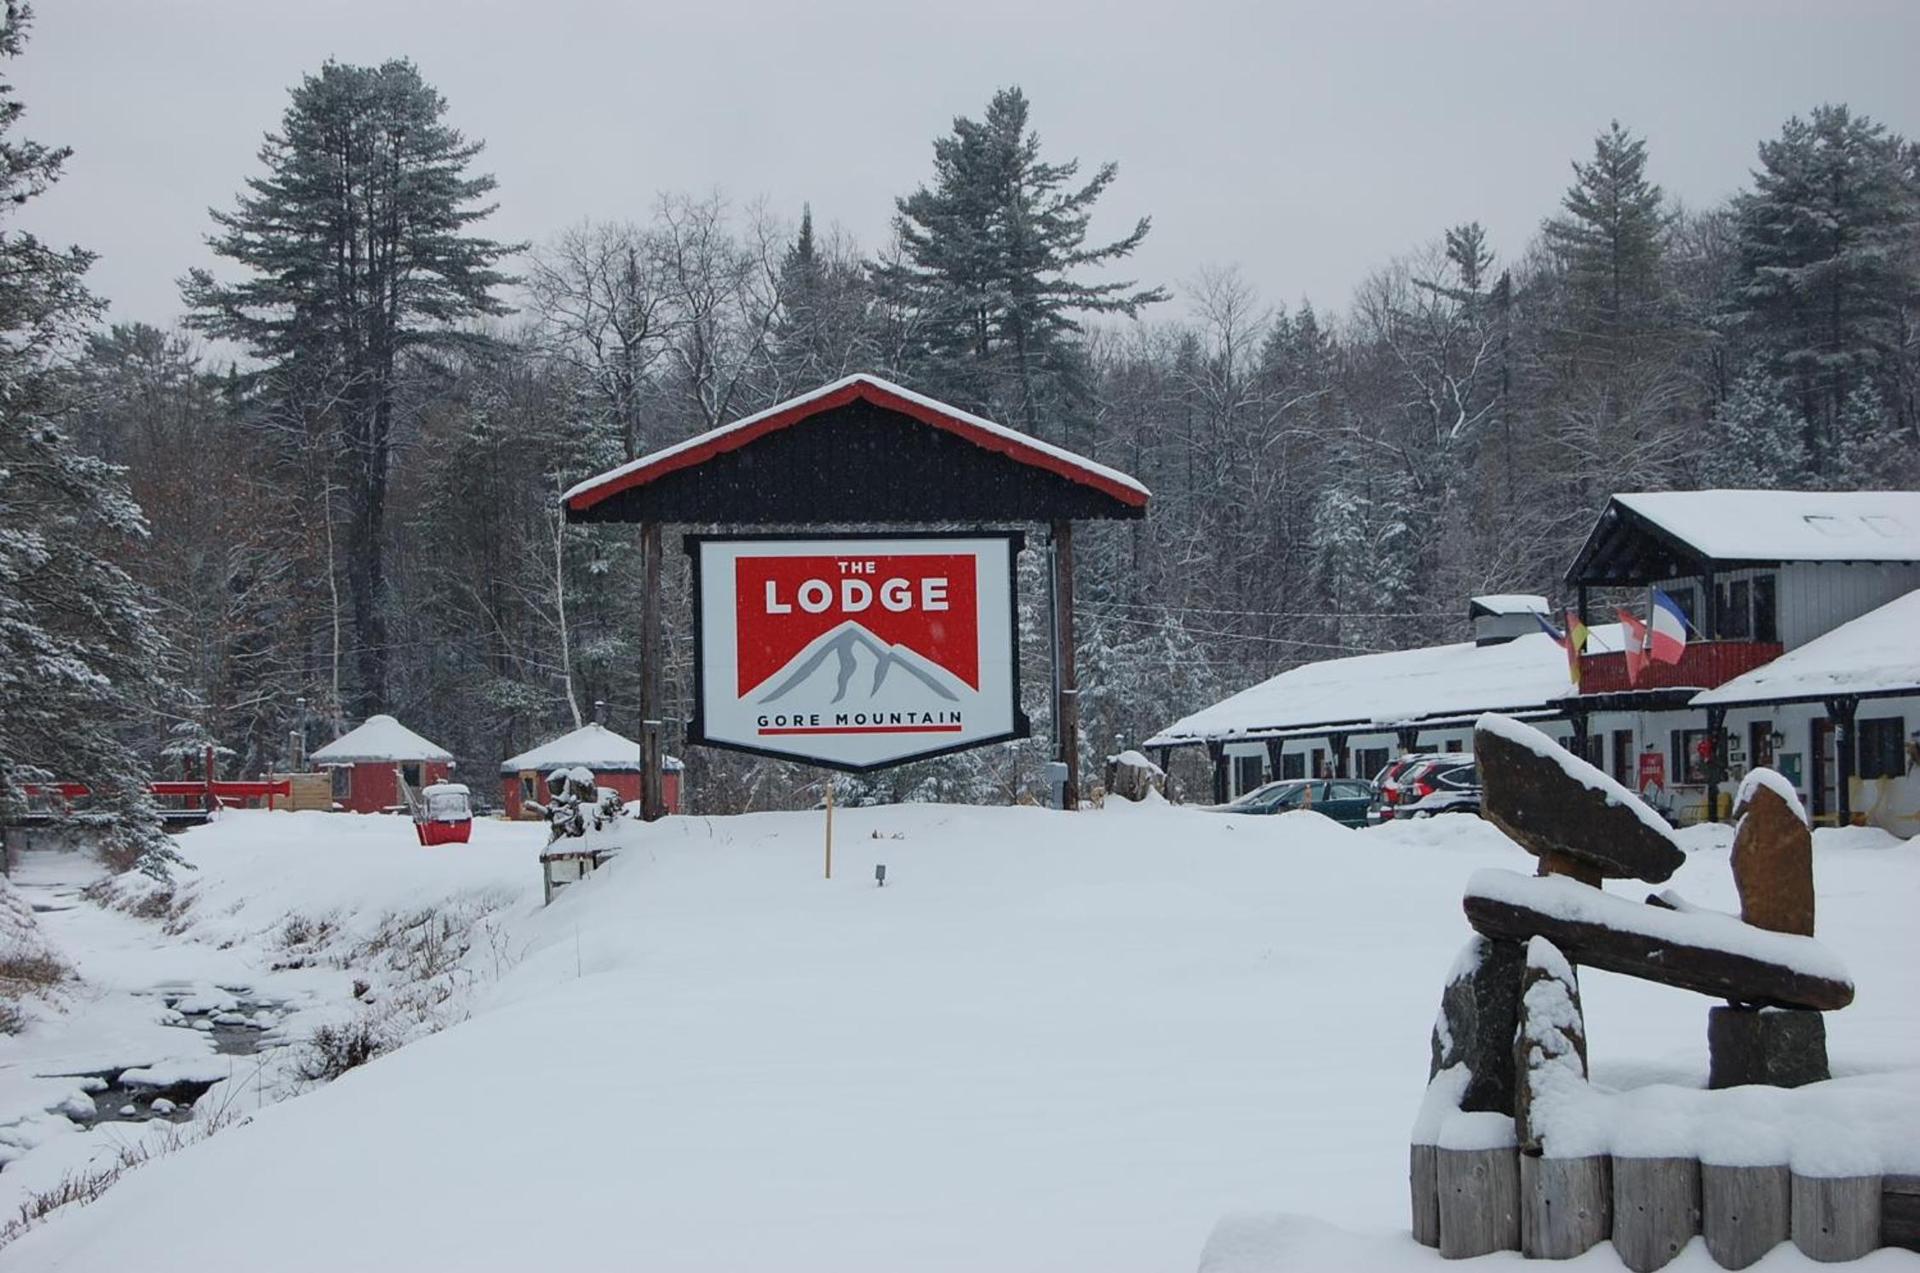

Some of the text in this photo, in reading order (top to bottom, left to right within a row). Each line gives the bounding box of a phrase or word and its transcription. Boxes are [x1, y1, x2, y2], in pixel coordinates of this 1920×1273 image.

[838, 561, 876, 574] THE
[765, 577, 949, 614] LODGE
[758, 711, 962, 726] GORE MOUNTAIN
